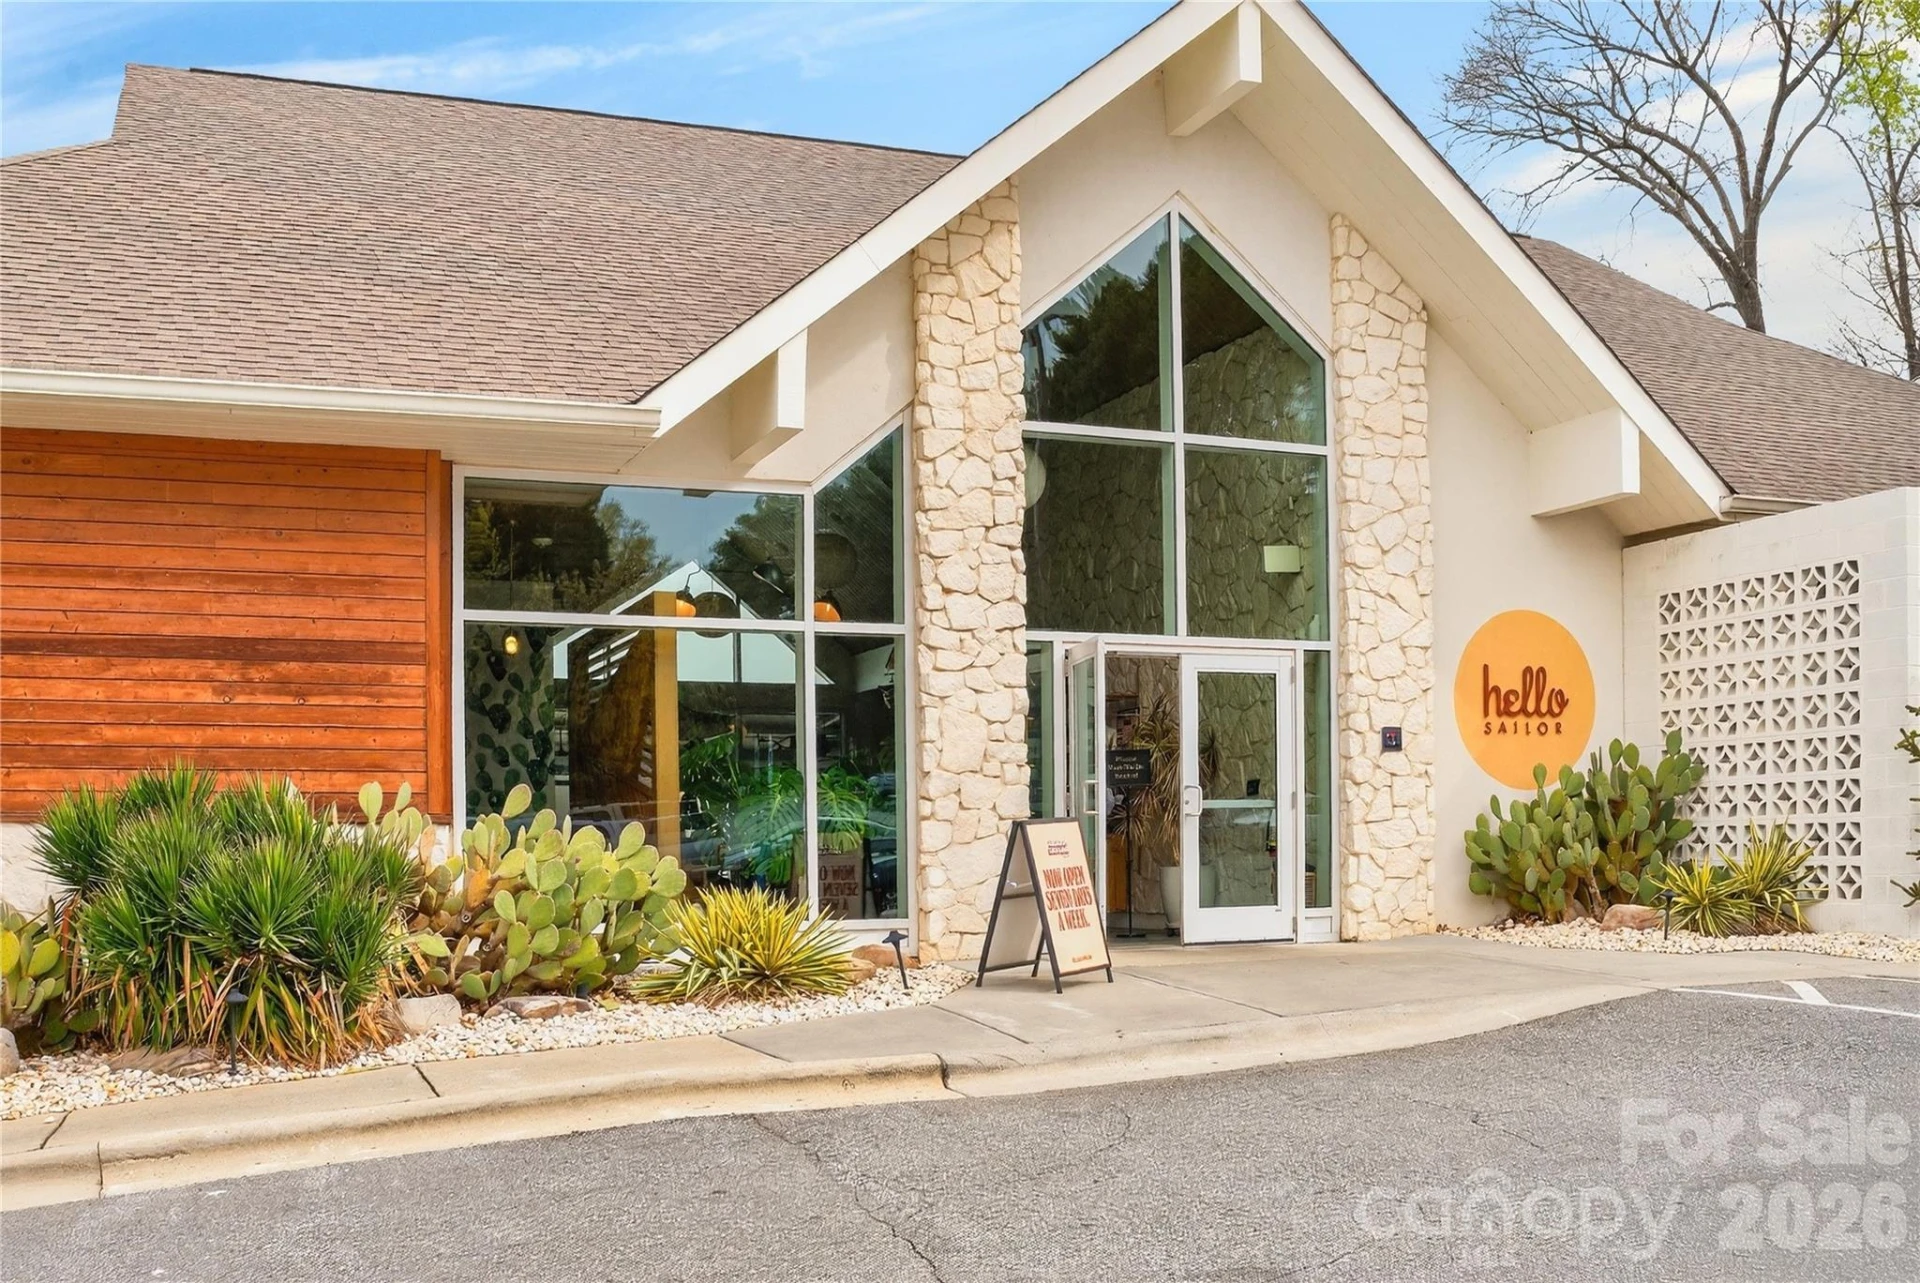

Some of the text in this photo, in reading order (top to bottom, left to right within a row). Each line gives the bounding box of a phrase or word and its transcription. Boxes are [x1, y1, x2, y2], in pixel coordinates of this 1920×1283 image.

[1483, 663, 1569, 718] hello
[1484, 721, 1562, 736] SAILOR
[1063, 865, 1086, 887] OPEN
[1045, 888, 1073, 911] SEVEN
[1058, 911, 1066, 931] A
